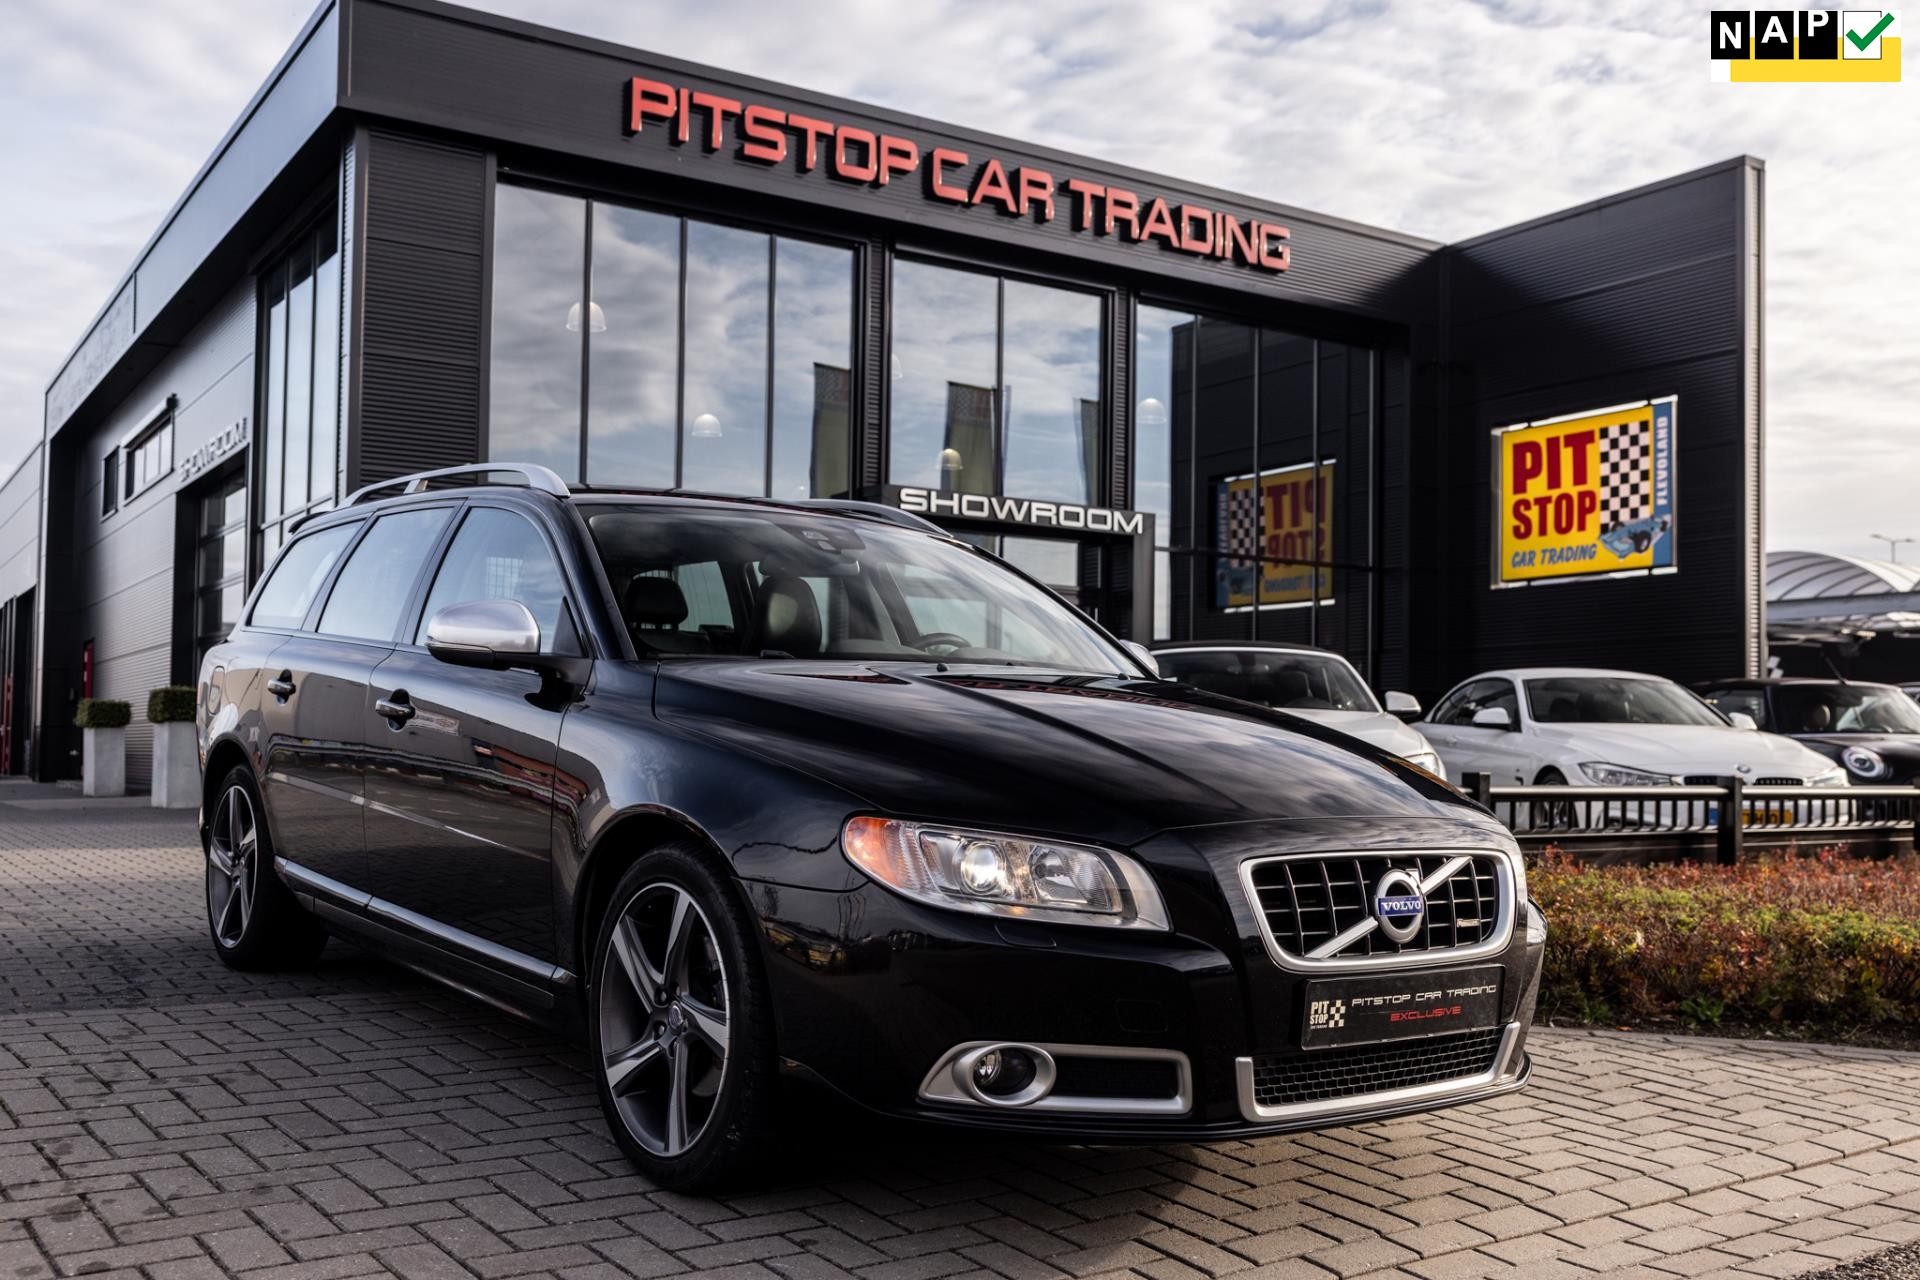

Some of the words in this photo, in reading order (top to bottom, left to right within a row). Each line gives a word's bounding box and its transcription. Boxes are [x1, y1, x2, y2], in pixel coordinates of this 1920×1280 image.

[629, 75, 919, 186] PITSTOP
[931, 147, 1055, 222] CAR
[1068, 177, 1292, 273] TRADING
[1512, 430, 1596, 495] PIT
[1655, 415, 1669, 506] FLEVOLAND
[899, 487, 1144, 535] SHOWROOM
[1512, 490, 1597, 541] STOP
[1511, 551, 1535, 569] CAR
[1540, 543, 1598, 566] TRADING
[1381, 900, 1421, 911] VOLVO
[1310, 1001, 1330, 1014] PIT
[1352, 994, 1411, 1007] PITSTOP
[1415, 989, 1442, 1002] CAR
[1309, 1013, 1329, 1024] STOP
[1389, 1006, 1462, 1023] EXCLUSIVE
